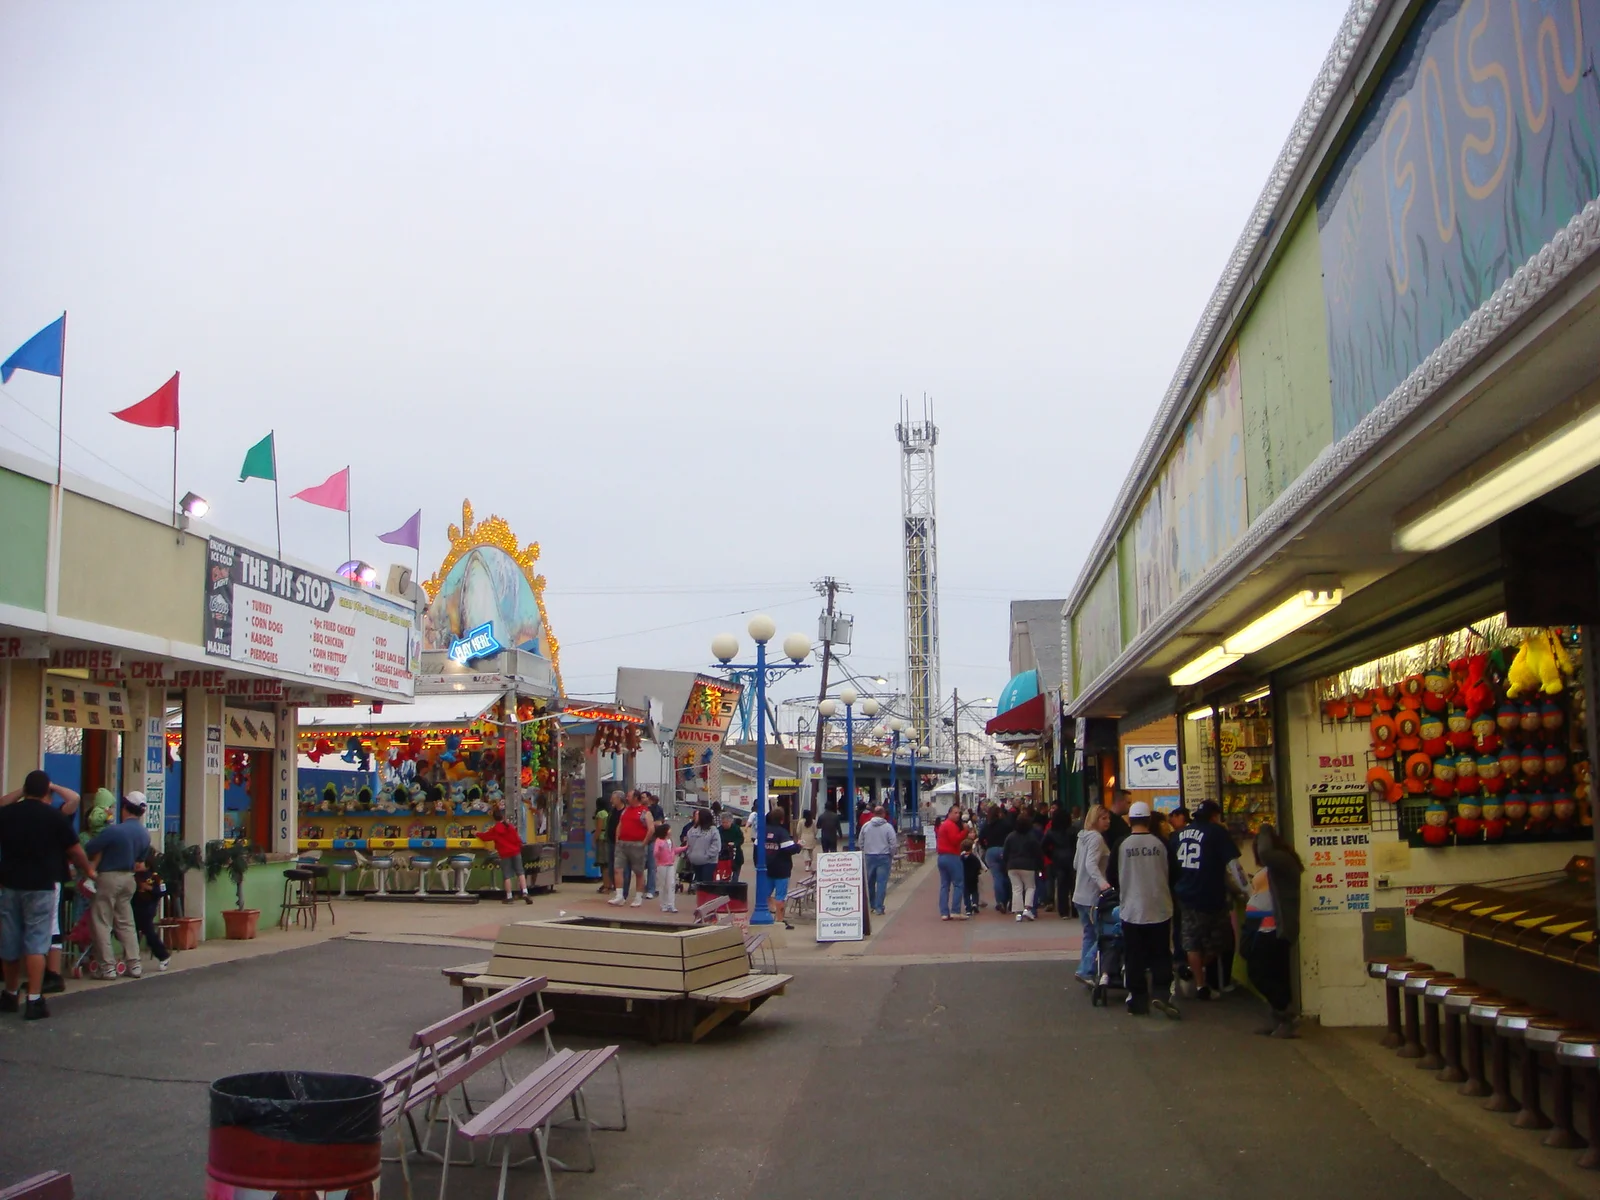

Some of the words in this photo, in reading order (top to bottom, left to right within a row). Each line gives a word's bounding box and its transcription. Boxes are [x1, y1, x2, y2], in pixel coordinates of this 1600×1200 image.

[210, 539, 226, 554] ENJOY
[226, 545, 235, 557] AN
[211, 551, 219, 562] ICE
[220, 553, 233, 567] COLD
[213, 578, 229, 590] LIGHT
[240, 553, 268, 590] THE
[272, 564, 294, 597] PIT
[296, 574, 330, 609] STOP
[252, 600, 272, 615] TURKEY
[251, 616, 267, 630] CORN
[268, 620, 283, 634] DOGS
[323, 619, 336, 632] FRIED
[337, 624, 356, 637] CHICKEN
[215, 627, 224, 640] AT
[251, 631, 273, 647] KABOBS
[313, 632, 323, 644] BBQ
[324, 636, 344, 649] CHICKEN
[455, 643, 472, 659] PLAY
[471, 632, 492, 651] HERE
[207, 640, 230, 656] MAXIES
[375, 649, 386, 660] BABY
[250, 647, 278, 663] PIEROGIES
[313, 647, 327, 660] CORN
[327, 651, 347, 664] FRITTERS
[131, 662, 164, 679] CHIX
[313, 662, 323, 673] HOT
[323, 664, 340, 677] WINGS
[375, 662, 393, 675] SAUSAGE
[254, 679, 282, 695] DOG
[375, 676, 389, 687] CHEESE
[1134, 751, 1161, 768] The
[1319, 754, 1354, 768] Roll
[1026, 765, 1046, 774] ATM
[1316, 796, 1364, 806] WINNER
[1317, 806, 1364, 815] EVERY
[1320, 815, 1363, 824] RACE!
[1179, 829, 1204, 842] RIVERA
[1310, 836, 1338, 846] PRIZE
[1341, 835, 1369, 845] LEVEL
[1141, 846, 1160, 856] Cafe
[1176, 842, 1201, 869] 42
[1314, 851, 1331, 861] 2-3
[1344, 850, 1367, 858] SMALL
[1315, 873, 1333, 883] 4-6
[1345, 871, 1369, 879] MEDIUM
[1347, 880, 1368, 888] PRIZE
[1346, 893, 1369, 901] LARGE
[1348, 902, 1369, 910] PRIZE
